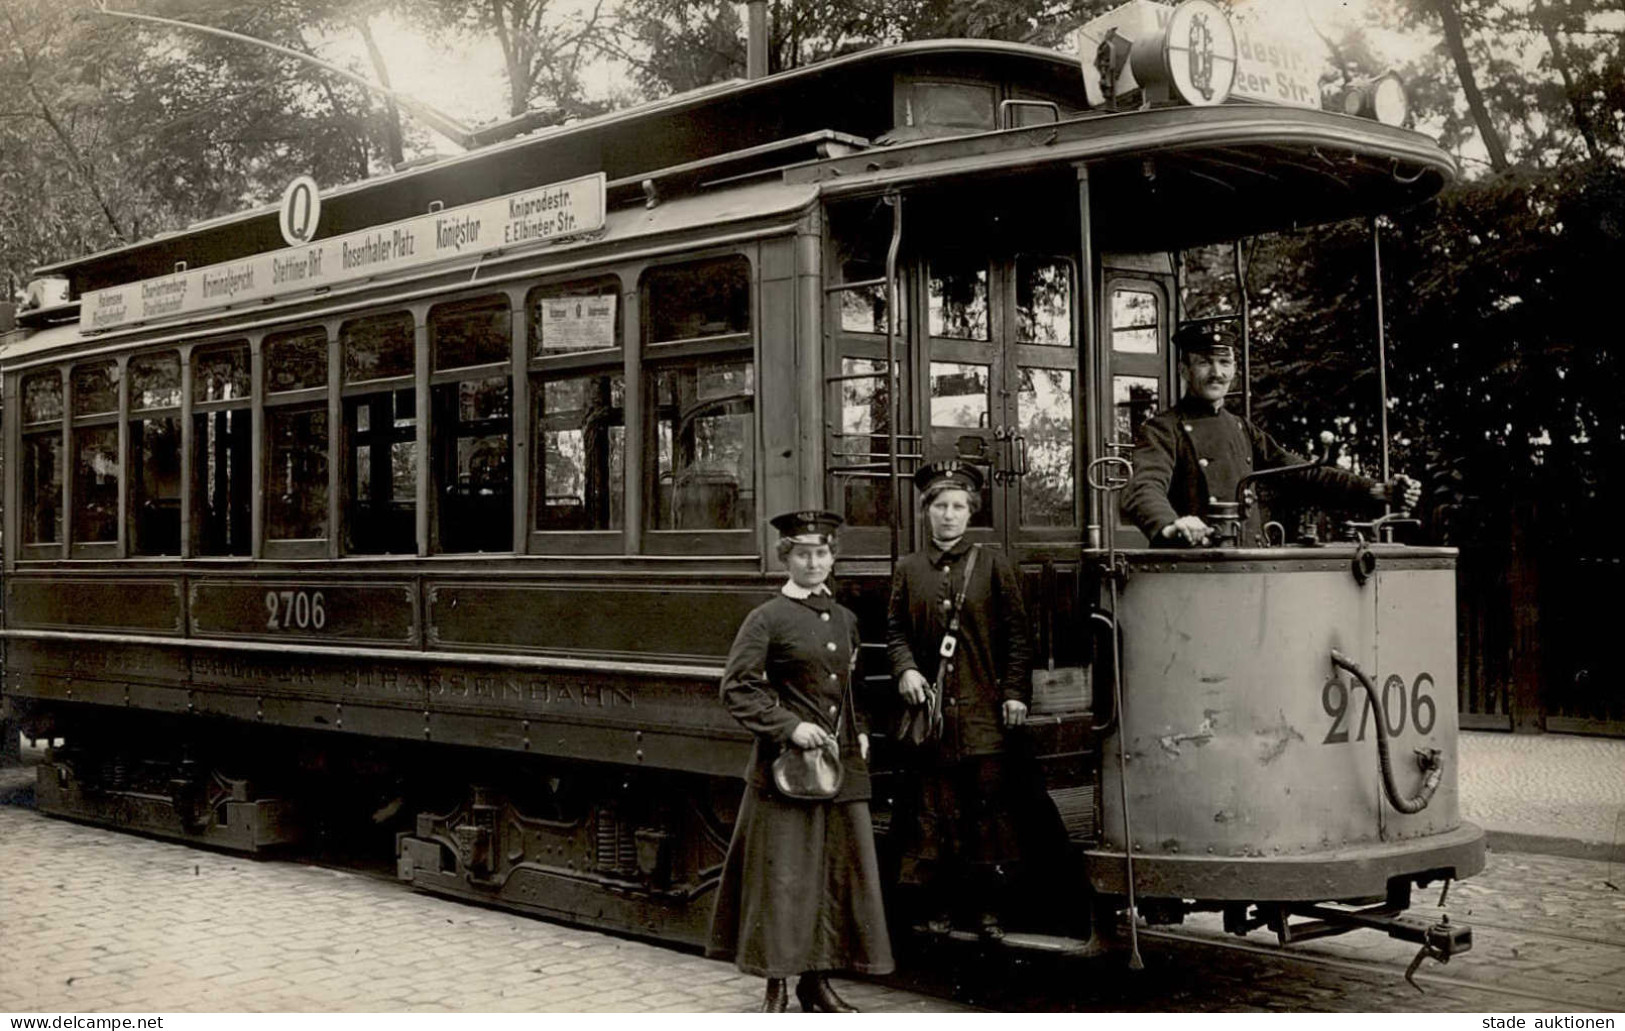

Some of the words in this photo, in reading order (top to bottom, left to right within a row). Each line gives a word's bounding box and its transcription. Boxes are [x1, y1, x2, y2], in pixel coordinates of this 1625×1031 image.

[1240, 32, 1308, 75] destr.
[1276, 72, 1315, 105] Str.
[288, 183, 311, 242] Q
[509, 187, 573, 219] Kniprodestr.
[557, 211, 577, 232] Str.
[342, 233, 391, 269] Rosenthaler
[393, 228, 414, 259] Platz
[436, 216, 480, 252] Königstor
[273, 256, 308, 285] Stettiner
[265, 591, 325, 629] 2706
[1322, 672, 1436, 744] 2706
